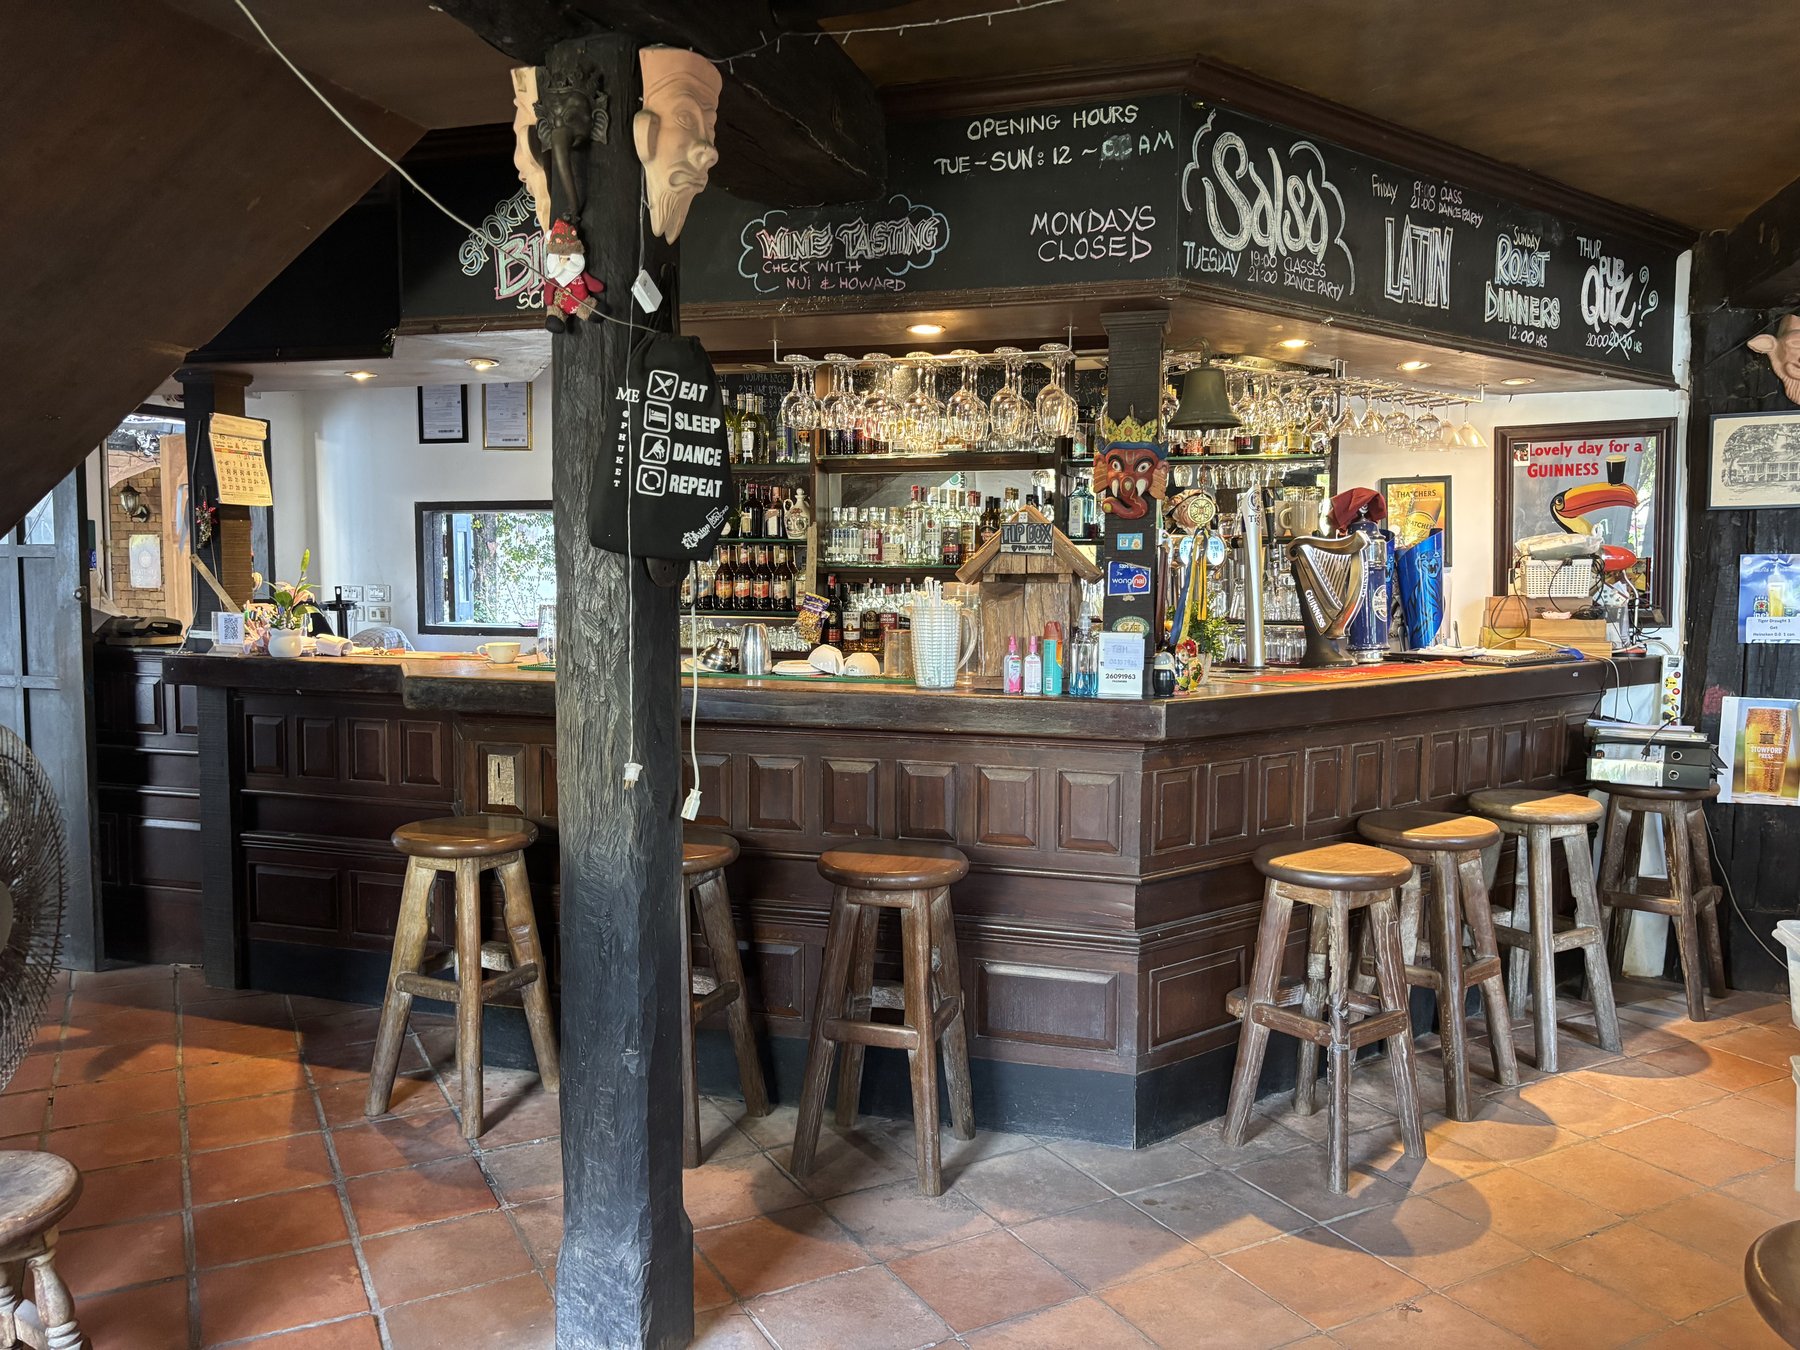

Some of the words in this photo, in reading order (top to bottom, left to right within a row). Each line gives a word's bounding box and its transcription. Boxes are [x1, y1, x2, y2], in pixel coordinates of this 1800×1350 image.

[967, 115, 1060, 140] OPENING
[1073, 104, 1139, 128] HOURS
[1053, 146, 1073, 165] 12
[1202, 132, 1328, 264] Salsa
[1438, 202, 1461, 218] DANCE
[1030, 205, 1156, 236] MONDAYS
[756, 222, 833, 261] WINE
[835, 216, 941, 260] TASTING
[1038, 231, 1152, 263] CLOSED
[1513, 226, 1541, 251] SUNDAY
[1577, 236, 1601, 259] THUR
[494, 231, 547, 300] BI
[762, 261, 810, 274] CHECK
[817, 260, 862, 274] WITH
[1183, 241, 1242, 277] TUESDAY
[1283, 257, 1326, 278] CLASSES
[1384, 214, 1453, 310] LATIN
[1495, 233, 1550, 288] ROAST
[1600, 256, 1625, 286] PUB
[839, 277, 906, 292] HOWARD
[1284, 273, 1315, 293] DANCE
[1317, 279, 1344, 301] PARTY
[1484, 281, 1560, 329] DINNERS
[1581, 264, 1636, 333] QUIZ
[1509, 325, 1534, 344] 12:00
[616, 387, 639, 403] ME
[679, 381, 708, 402] EAT
[674, 412, 721, 434] SLEEP
[613, 421, 627, 487] PHUKET
[672, 443, 722, 467] DANCE
[1529, 442, 1572, 458] Lovely
[1577, 441, 1603, 456] day
[1609, 440, 1629, 453] for
[1633, 442, 1643, 452] a
[1527, 462, 1599, 478] GUINNESS
[669, 474, 723, 498] REPEAT
[1001, 524, 1025, 543] TIP
[1026, 524, 1052, 543] BOX
[1305, 590, 1326, 628] GUINNESS
[1750, 745, 1783, 754] STOWFORD
